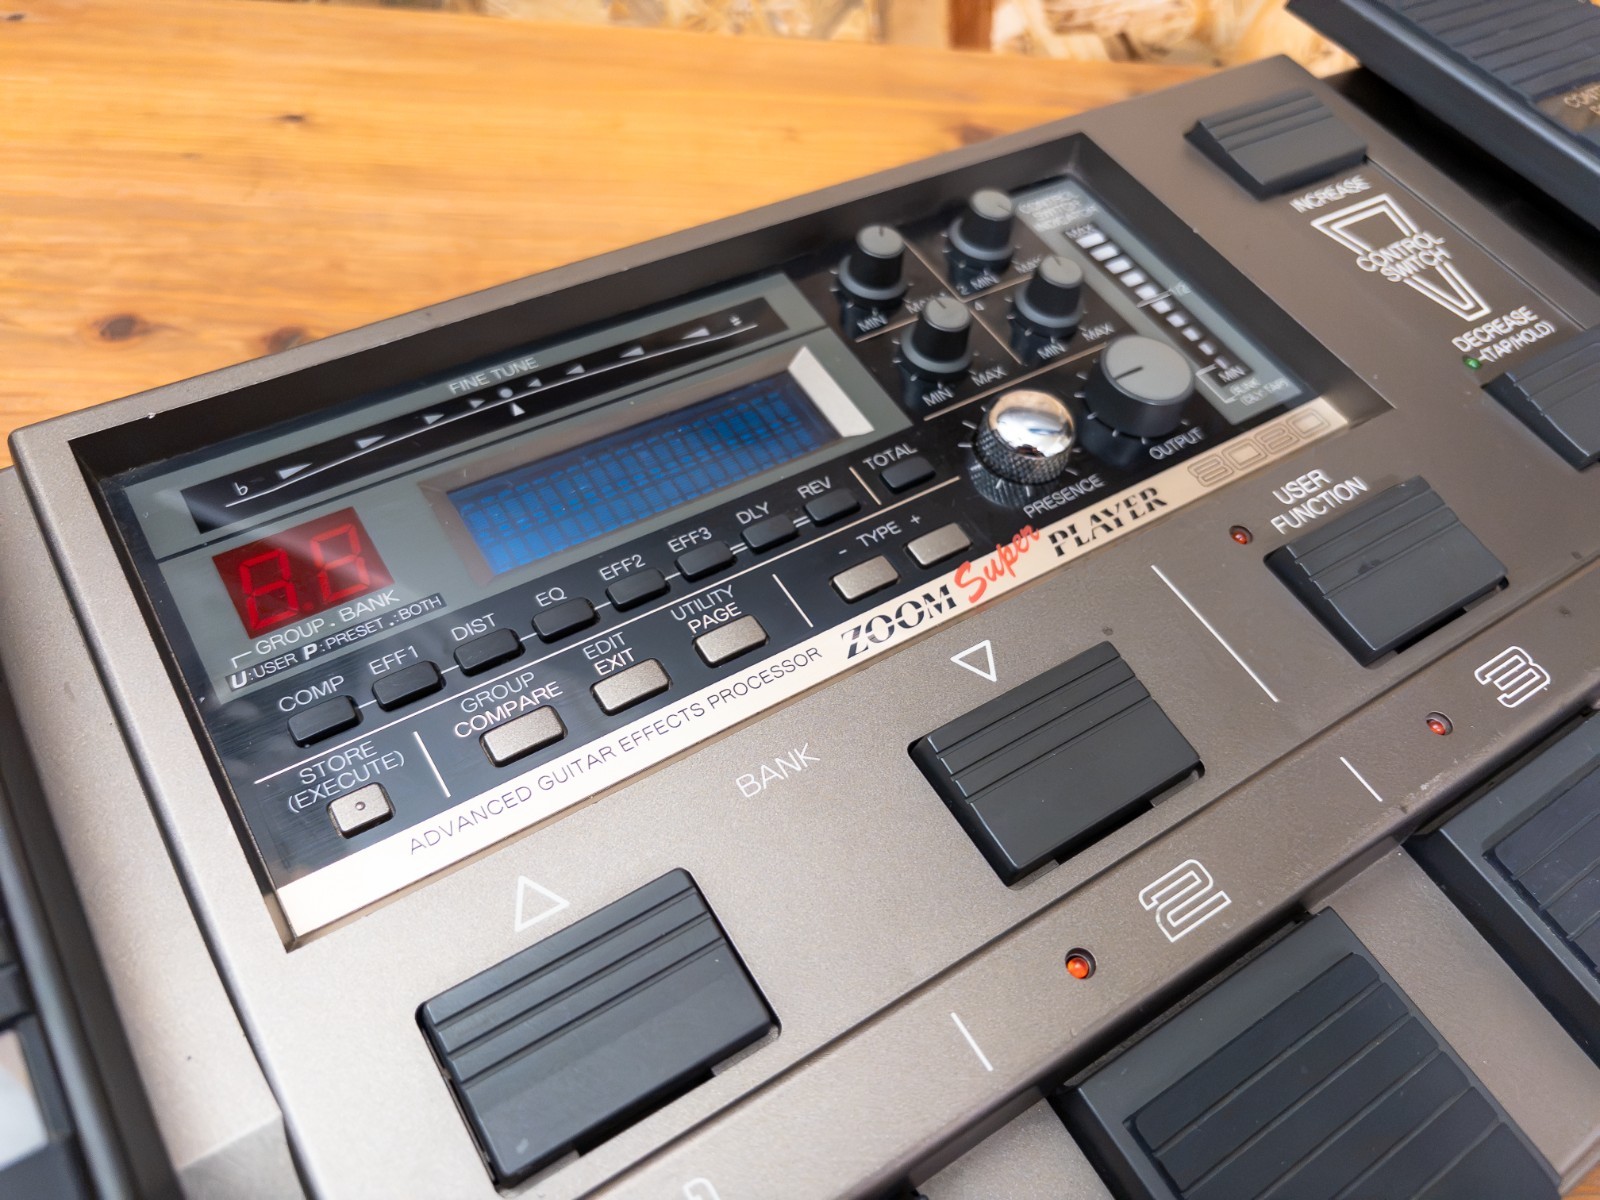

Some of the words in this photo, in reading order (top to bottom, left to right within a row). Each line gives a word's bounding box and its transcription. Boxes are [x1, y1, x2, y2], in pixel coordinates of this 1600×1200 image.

[1289, 175, 1373, 214] INCREASE
[1356, 231, 1446, 272] CONTROL
[1380, 246, 1453, 283] SWITCH
[970, 272, 1000, 291] MIN
[857, 312, 889, 333] MIN
[1081, 322, 1116, 342] MAX
[1451, 305, 1539, 353] DECREASE
[1037, 341, 1067, 361] MIN
[449, 373, 488, 395] FINE
[489, 356, 540, 381] TUNE
[971, 366, 1008, 388] MAX
[1217, 364, 1247, 383] MIN
[921, 387, 955, 408] MIN
[862, 443, 918, 472] TOTAL
[1148, 427, 1206, 460] OUTPUT
[1187, 407, 1331, 488] 8080
[796, 476, 833, 499] REV
[1023, 473, 1107, 519] PRESENCE
[1272, 468, 1333, 505] USER
[735, 501, 772, 526] DLY
[1269, 476, 1368, 535] FUNCTION
[667, 526, 713, 554] EFF3
[856, 520, 903, 549] TYPE
[599, 554, 646, 582] EFF2
[840, 583, 958, 660] ZOOM
[954, 523, 1041, 604] Super
[1047, 486, 1169, 558] PLAYER
[535, 586, 568, 608] EQ
[670, 584, 735, 622] UTILITY
[254, 617, 325, 656] GROUP
[339, 589, 401, 623] BANK
[451, 612, 498, 642] DIST
[687, 602, 743, 635] PAGE
[368, 644, 419, 675] EFF1
[582, 631, 627, 661] EDIT
[594, 648, 636, 677] EXIT
[278, 674, 345, 713] COMP
[460, 671, 536, 714] GROUP
[1473, 645, 1551, 709] 3
[453, 681, 564, 739] COMPARE
[300, 740, 379, 785] STORE
[409, 785, 533, 856] ADVANCED
[538, 745, 617, 792] GUITAR
[618, 702, 706, 754] EFFECTS
[707, 646, 823, 710] PROCESSOR
[287, 750, 405, 814] (EXECUTE)
[735, 742, 821, 799] BANK
[1138, 859, 1232, 943] 2
